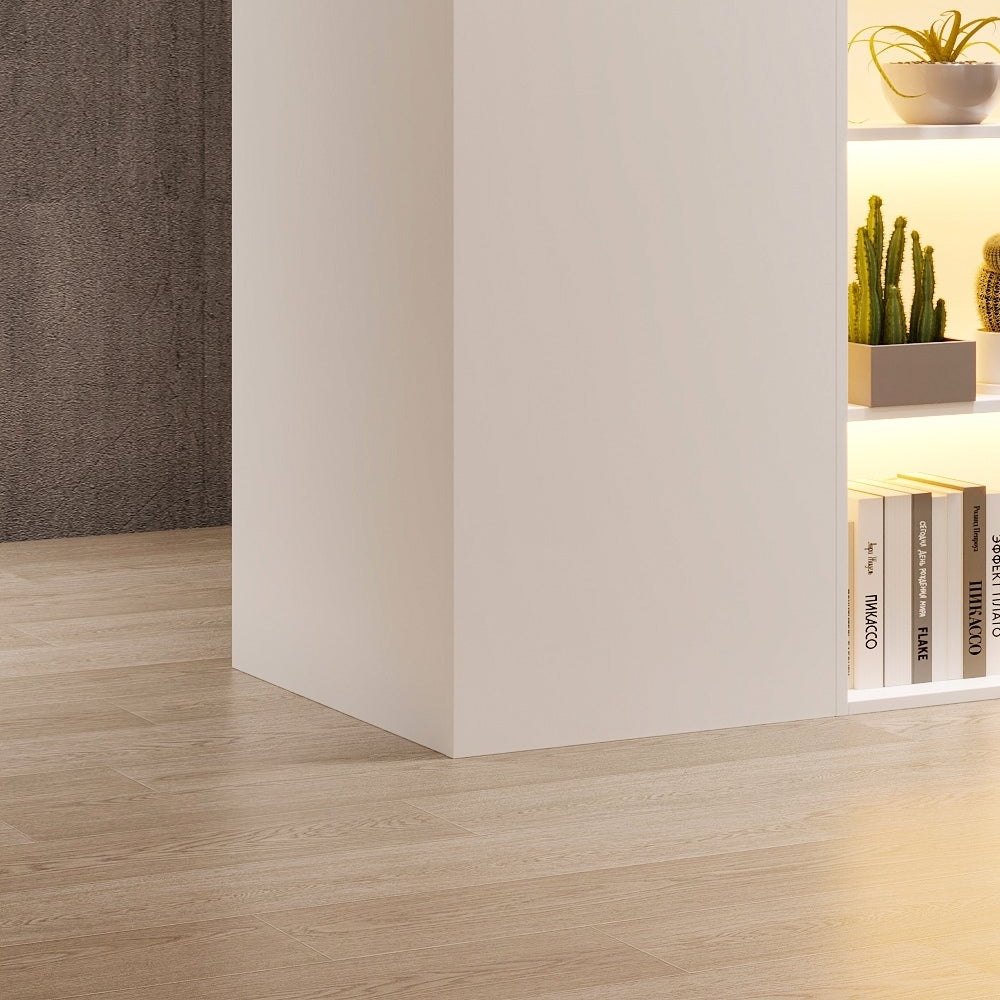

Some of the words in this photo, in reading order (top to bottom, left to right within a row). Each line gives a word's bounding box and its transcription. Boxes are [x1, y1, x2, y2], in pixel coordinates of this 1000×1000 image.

[865, 594, 878, 650] ПИКАССО
[919, 601, 927, 618] МИРА
[968, 580, 982, 656] ПИКАССО
[918, 627, 928, 661] FLAKE
